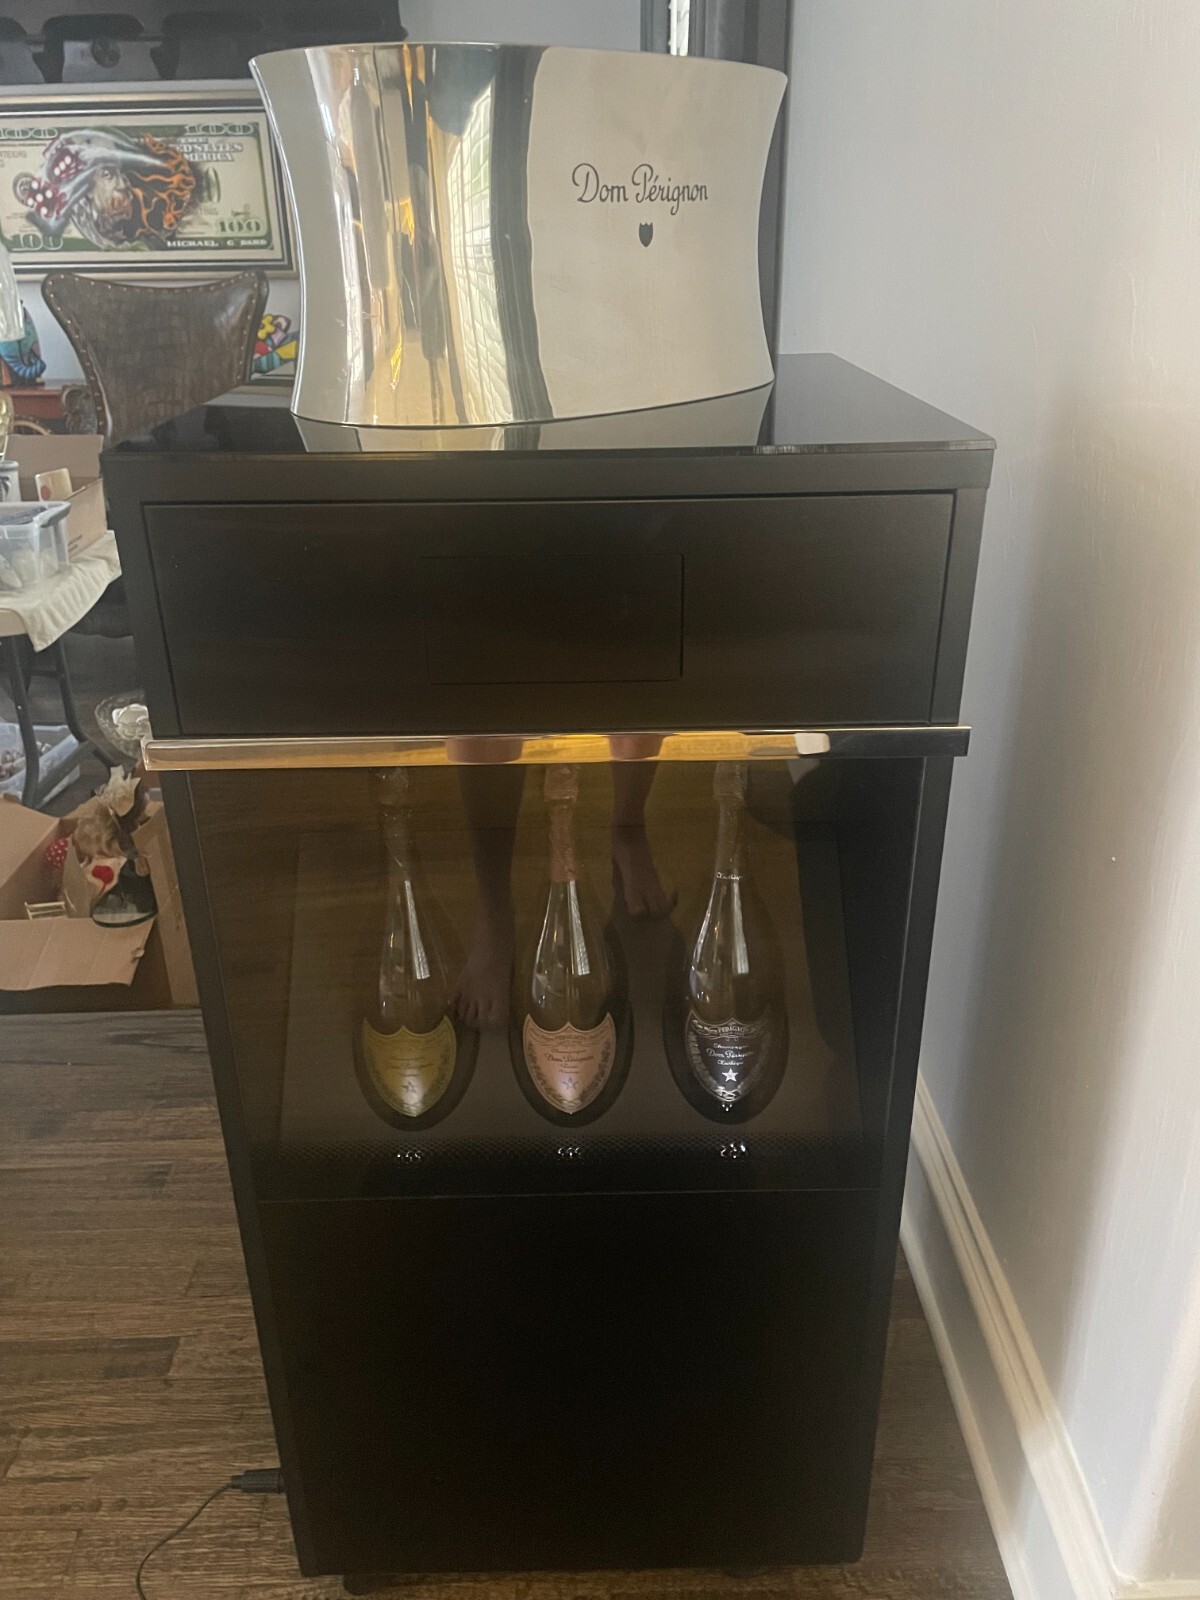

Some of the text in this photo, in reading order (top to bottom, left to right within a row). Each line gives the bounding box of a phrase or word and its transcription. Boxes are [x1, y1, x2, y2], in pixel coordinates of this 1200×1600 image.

[184, 123, 254, 136] 100
[572, 163, 708, 216] Dom Pérignon
[219, 219, 262, 232] 100
[166, 240, 219, 248] MICHAEL
